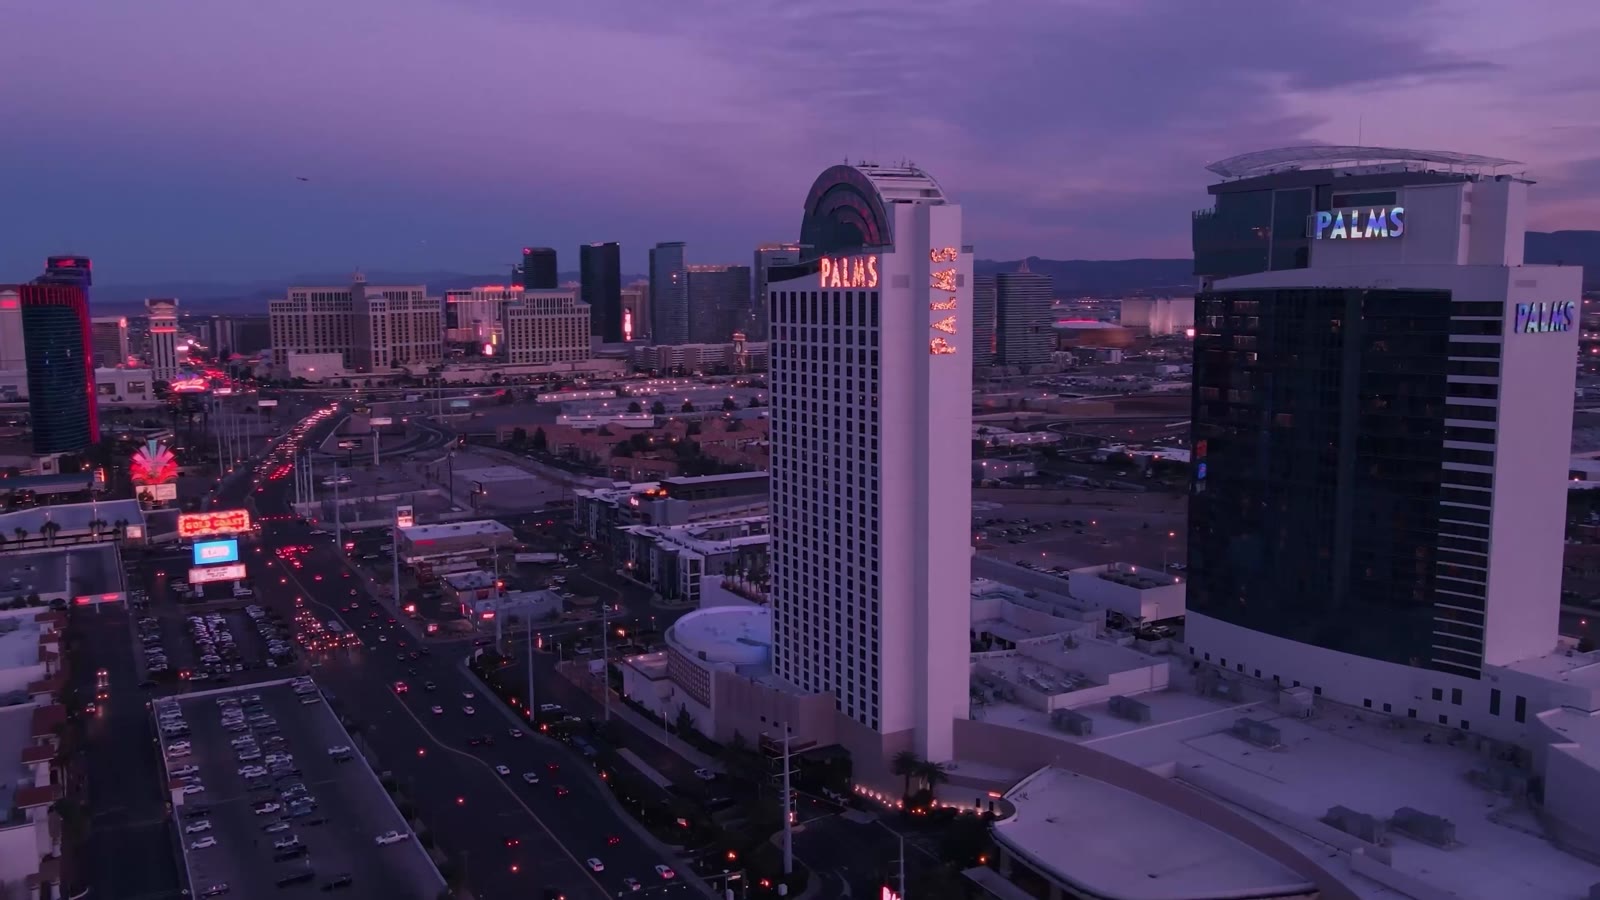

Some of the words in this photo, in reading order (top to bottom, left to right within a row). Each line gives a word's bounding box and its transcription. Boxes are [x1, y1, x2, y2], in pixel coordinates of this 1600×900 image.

[1316, 207, 1404, 239] PALMS
[820, 255, 878, 288] PALMS
[930, 247, 957, 355] PALMS
[1514, 301, 1575, 334] PALMS
[185, 520, 211, 530] GOLD
[213, 517, 243, 527] COAST
